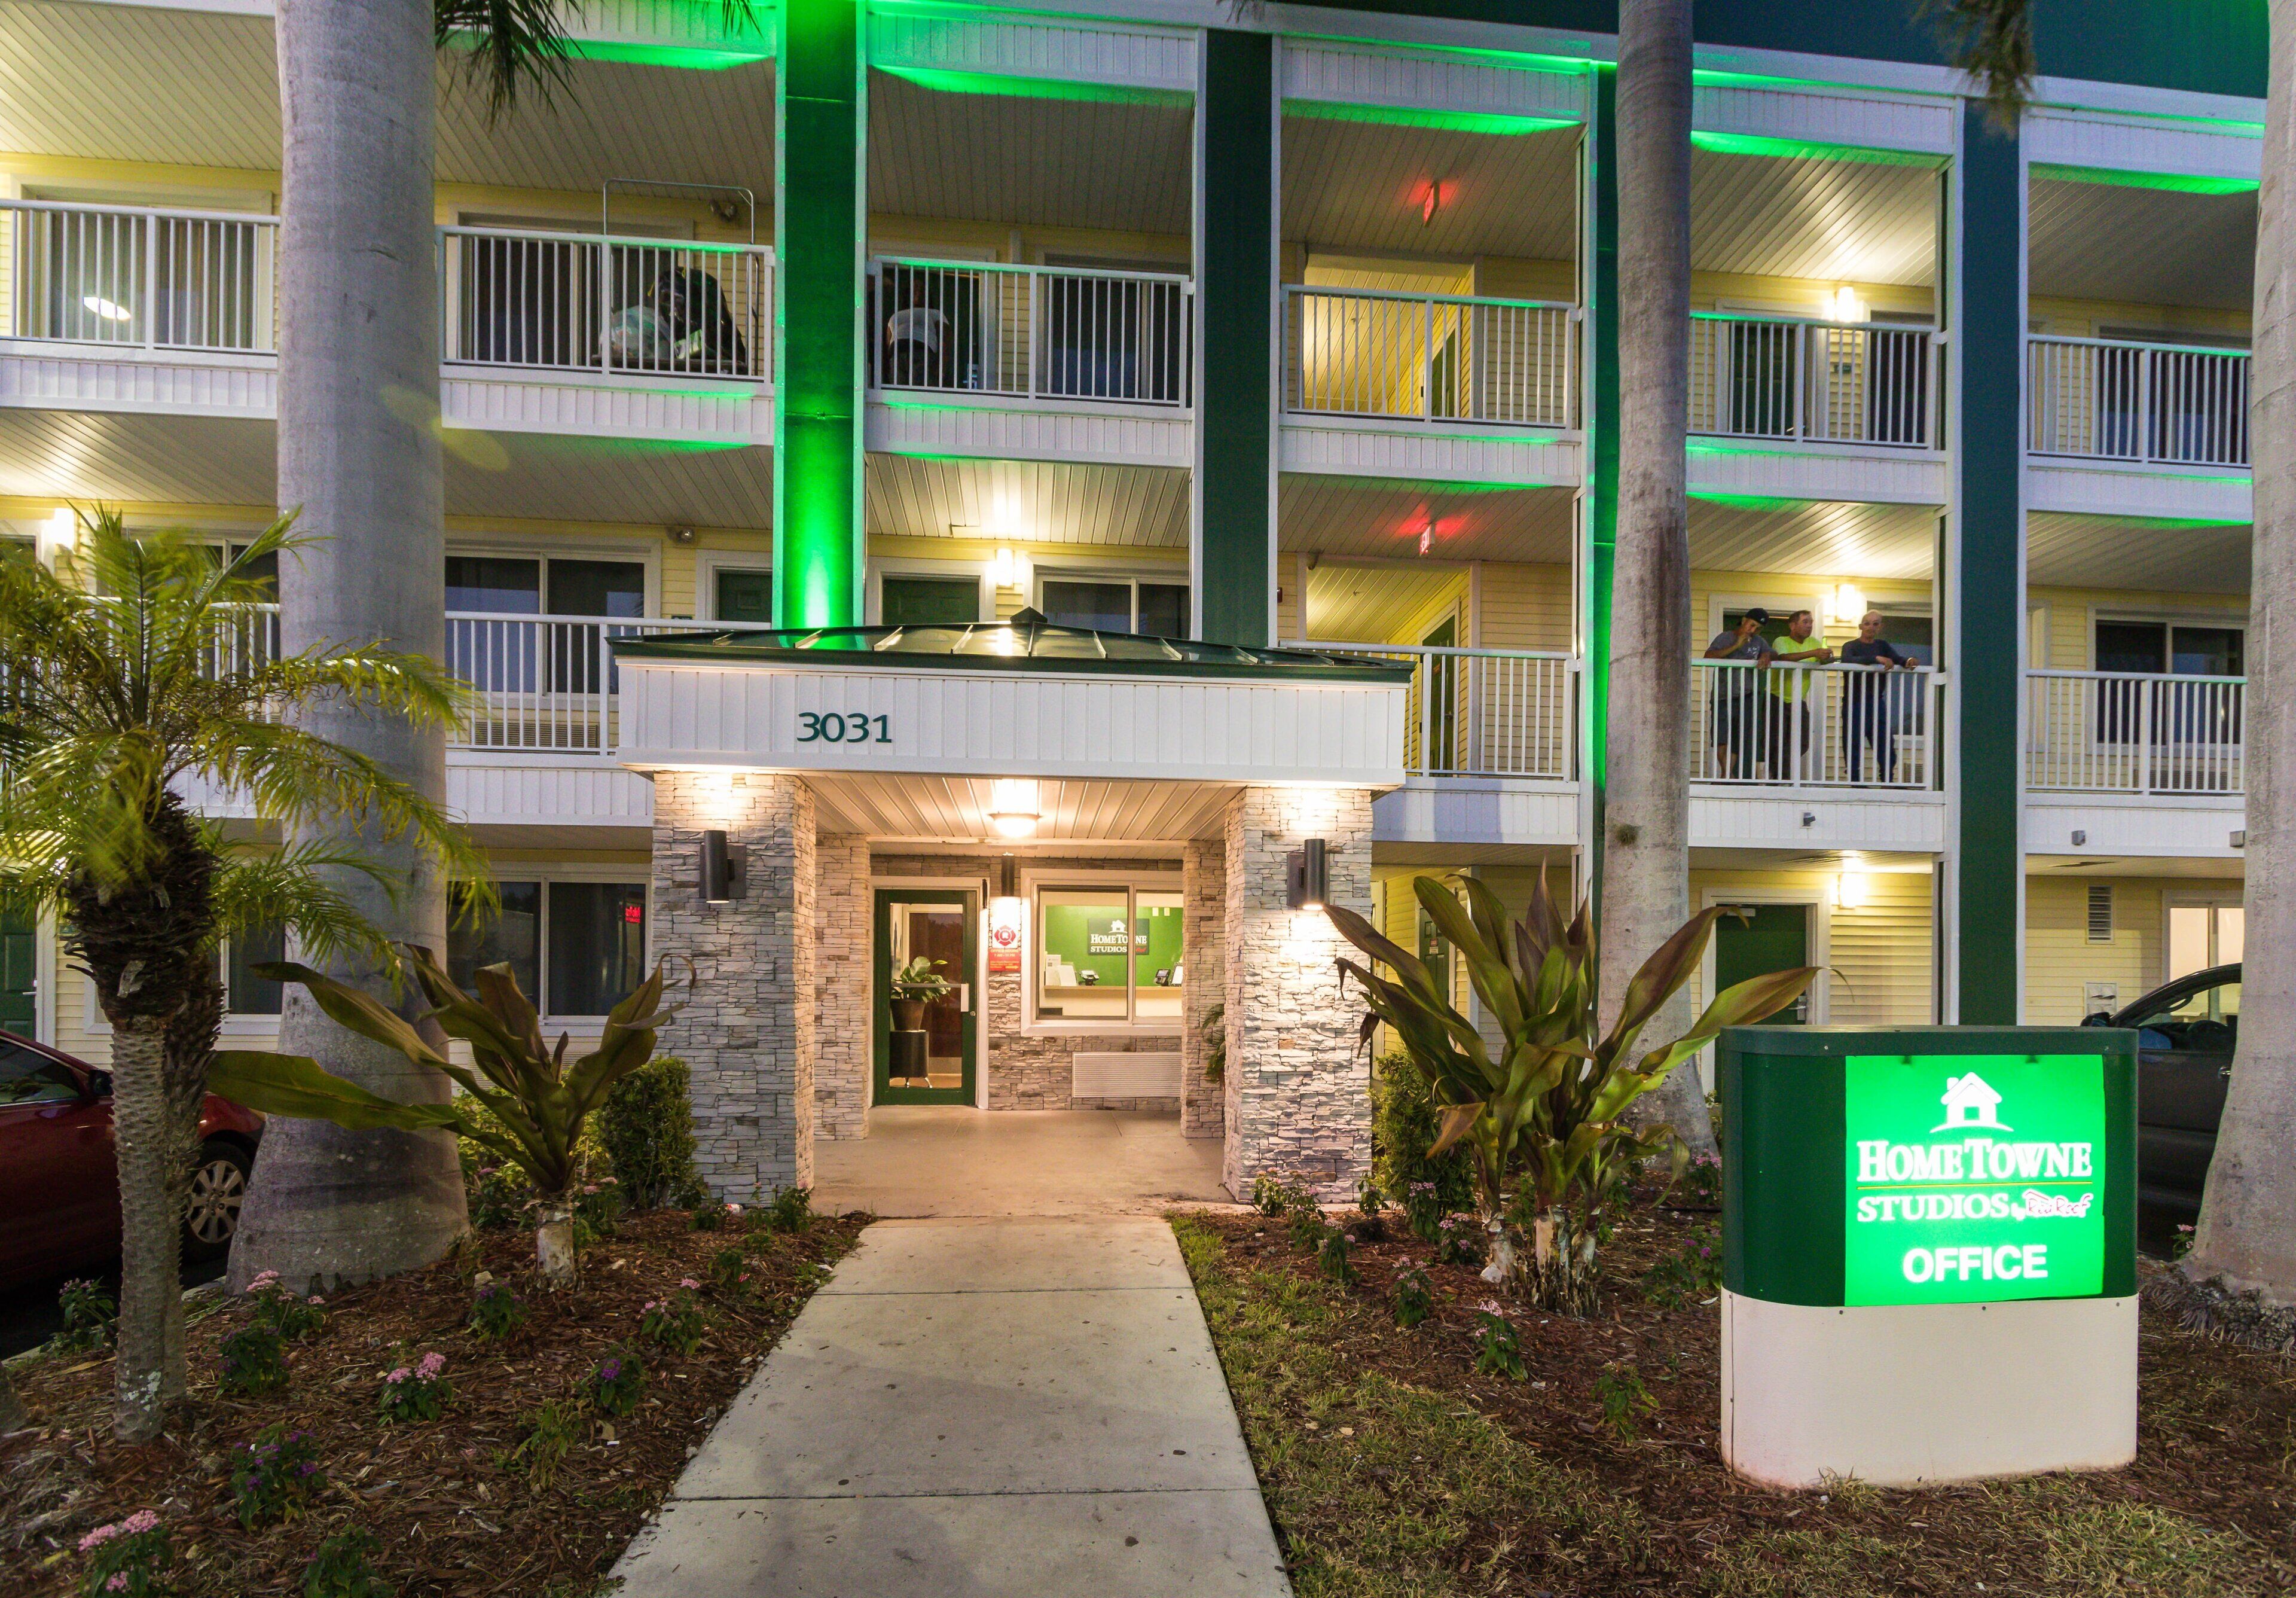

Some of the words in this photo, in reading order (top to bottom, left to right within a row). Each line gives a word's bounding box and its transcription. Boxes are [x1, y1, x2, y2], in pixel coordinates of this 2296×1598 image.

[797, 712, 891, 743] 3031
[1090, 934, 1147, 944] HOMETONE
[1857, 1139, 2093, 1182] HOMETOWNE
[1857, 1193, 2010, 1222] STUDIOS
[1903, 1245, 2048, 1283] OFFICE
